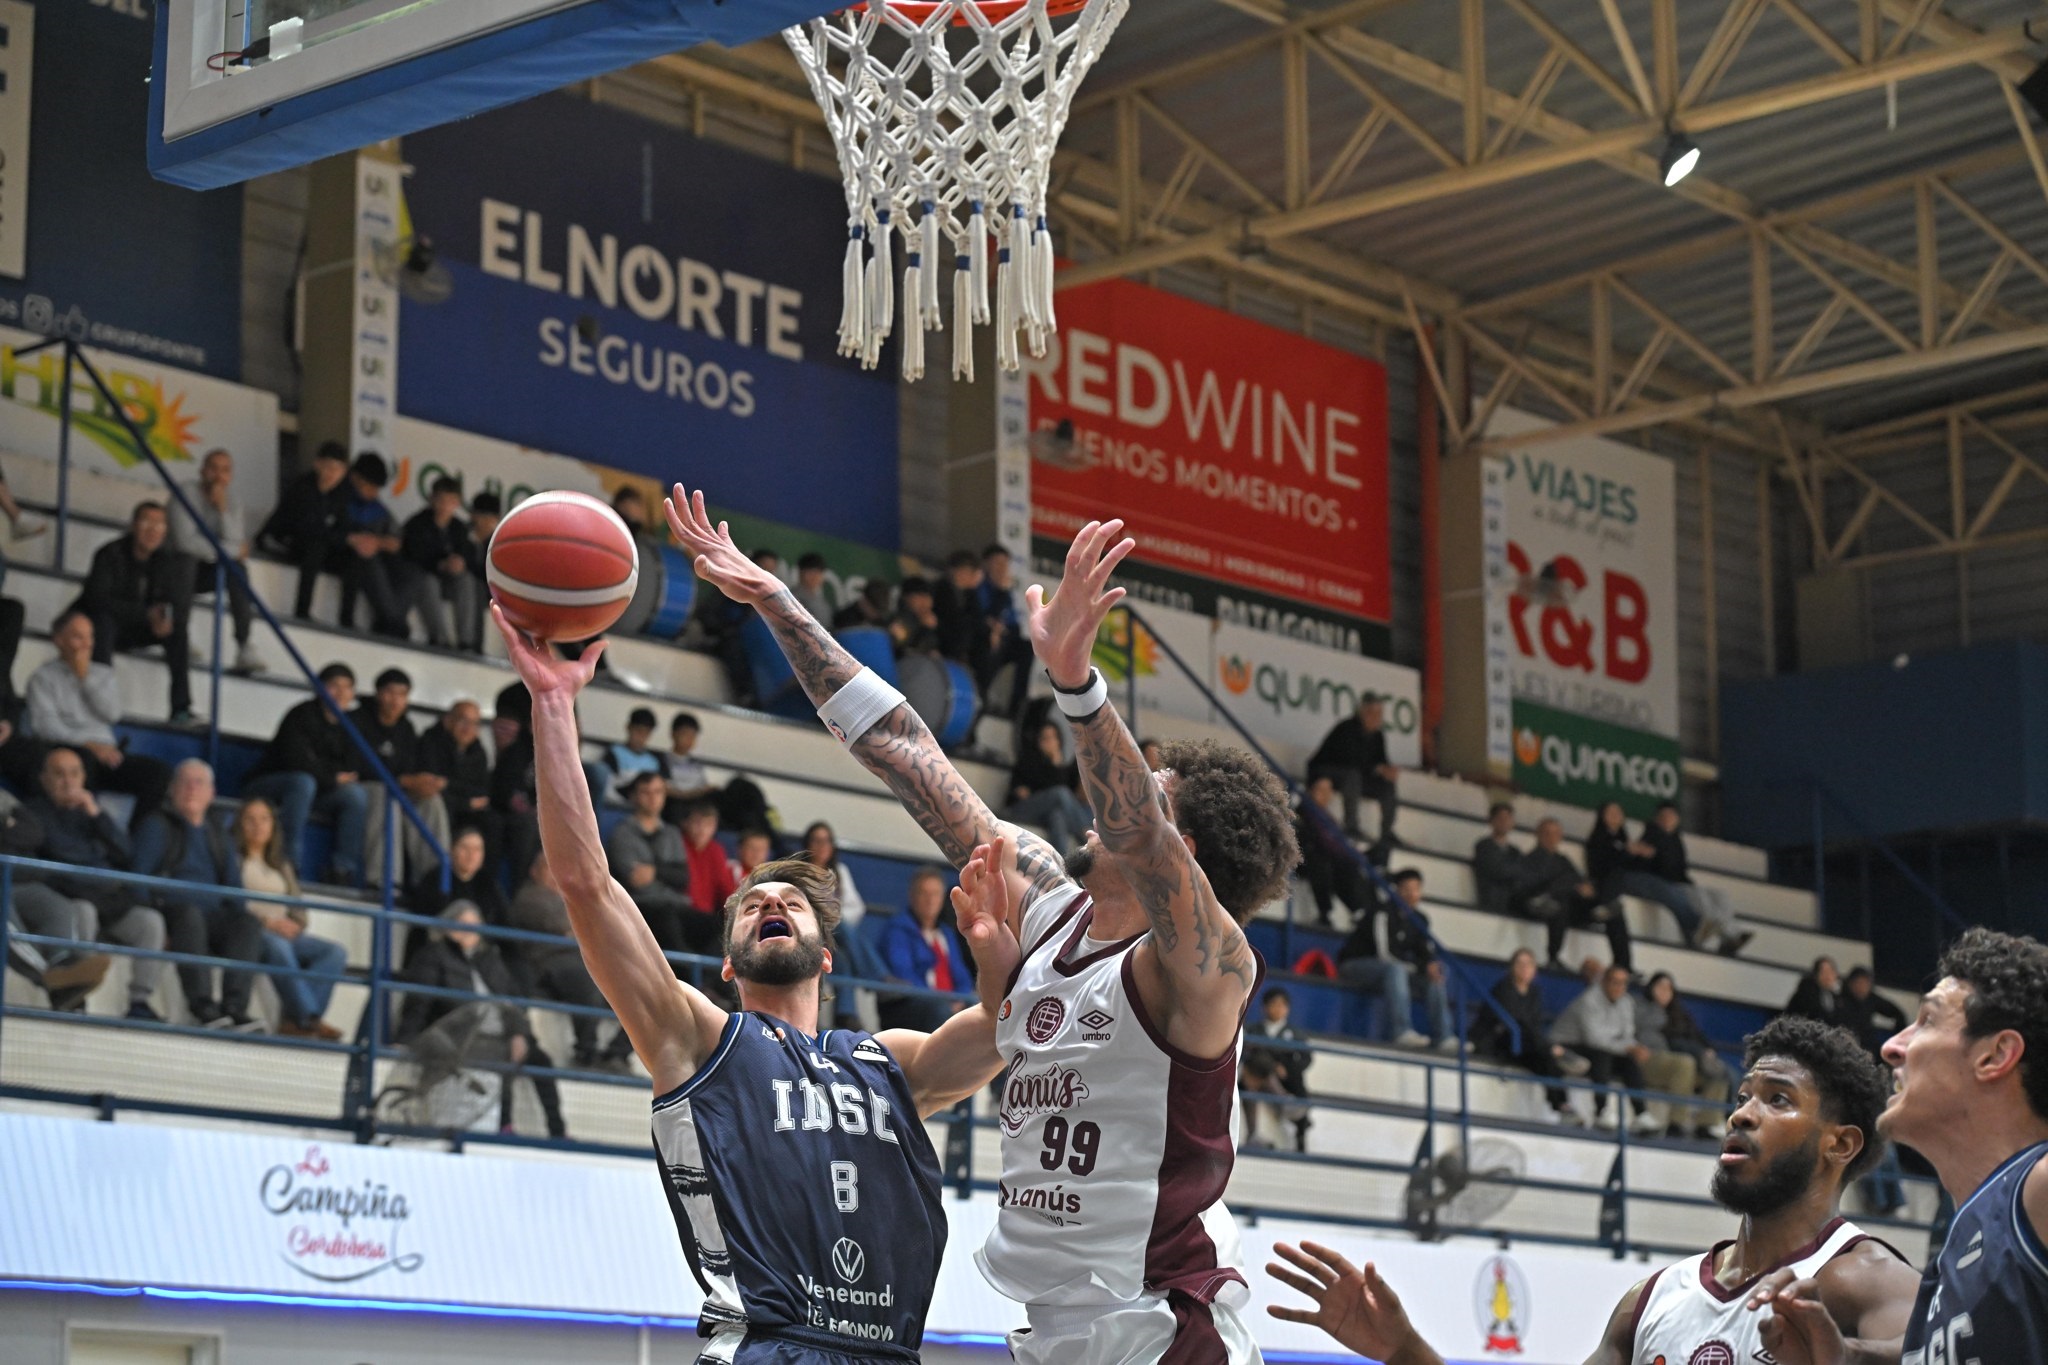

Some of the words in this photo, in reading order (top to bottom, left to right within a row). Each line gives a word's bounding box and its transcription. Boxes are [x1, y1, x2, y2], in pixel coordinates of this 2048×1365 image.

[538, 317, 756, 418] SEGUROS
[1523, 453, 1638, 526] VIAJES
[1082, 1031, 1111, 1041] umbro
[1040, 1115, 1101, 1176] 99
[260, 1164, 410, 1228] Campiña
[830, 1160, 859, 1213] 8
[1010, 1184, 1082, 1213] Lanús
